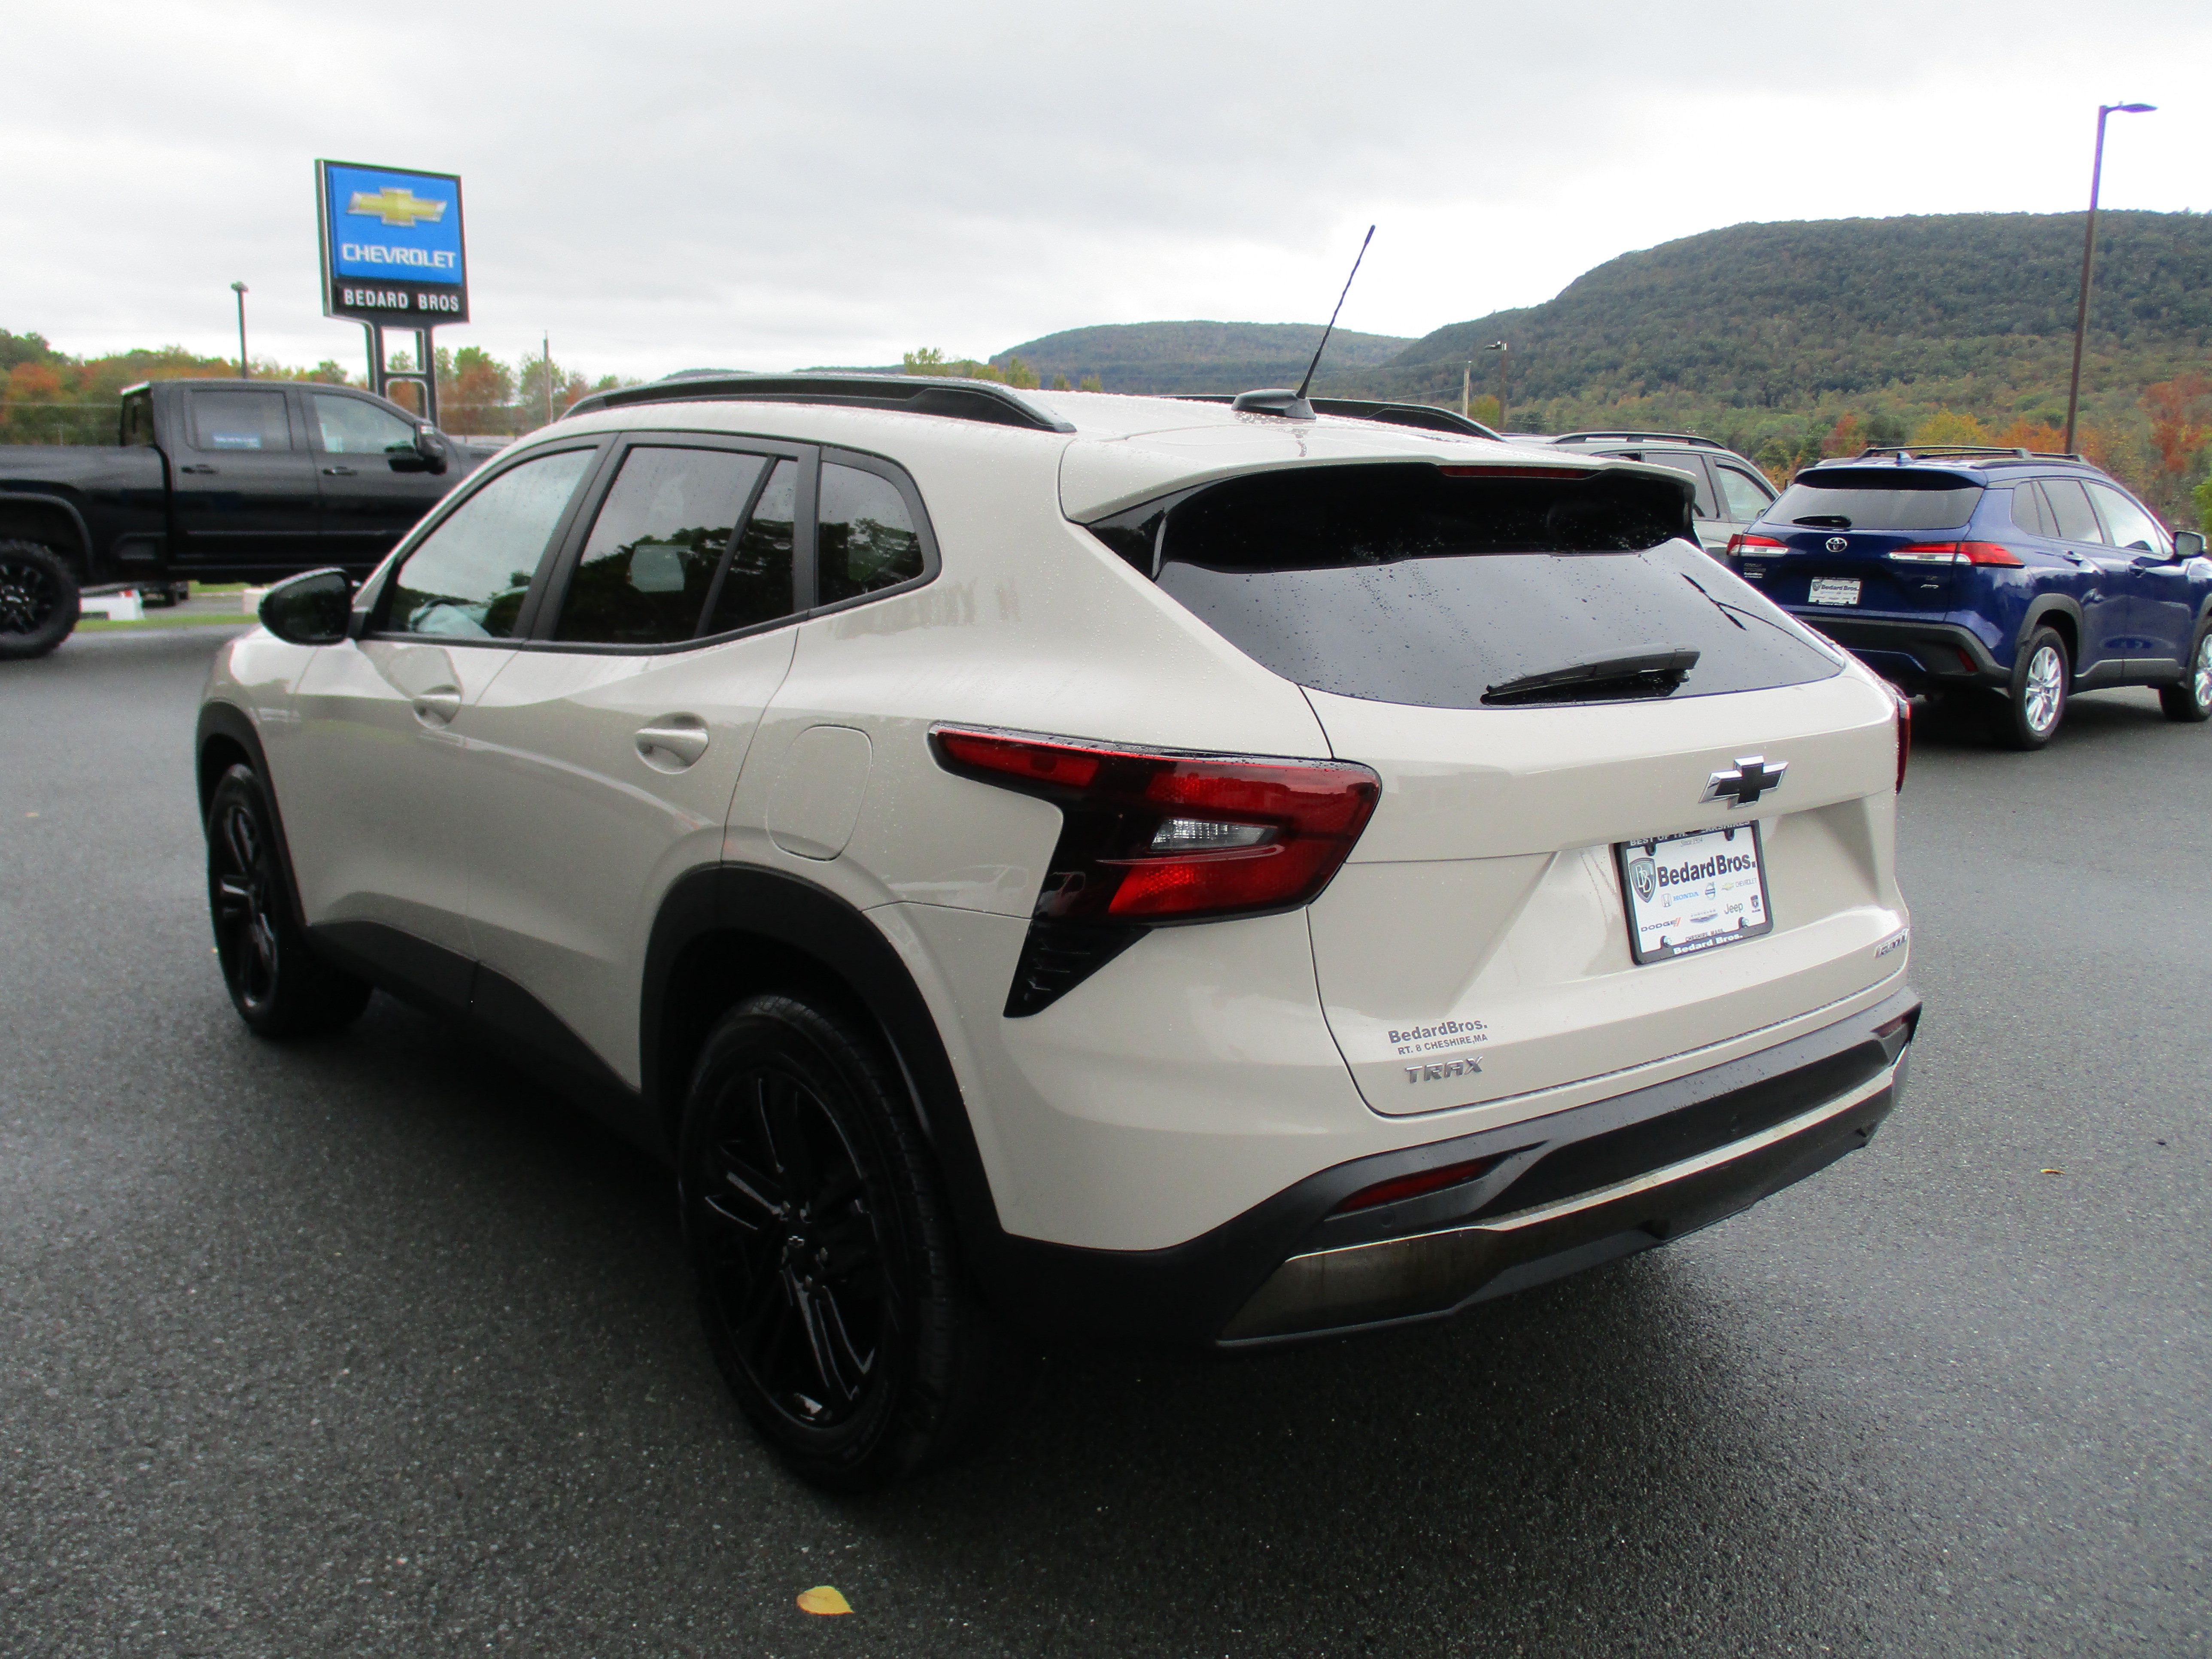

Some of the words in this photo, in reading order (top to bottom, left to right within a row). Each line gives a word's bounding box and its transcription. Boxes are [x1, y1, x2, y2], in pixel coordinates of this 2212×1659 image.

[342, 243, 456, 268] CHEVROLET
[343, 289, 409, 309] BEDARD
[417, 293, 460, 312] BROS
[1673, 891, 1699, 901] HONDA
[1724, 903, 1744, 915] Jeep
[1641, 920, 1677, 932] DODGE
[1673, 939, 1714, 954] Bedard
[1715, 933, 1743, 944] Bros.
[1398, 1045, 1413, 1054] RT.
[1415, 1044, 1422, 1052] 8
[1405, 1056, 1483, 1084] TRAX
